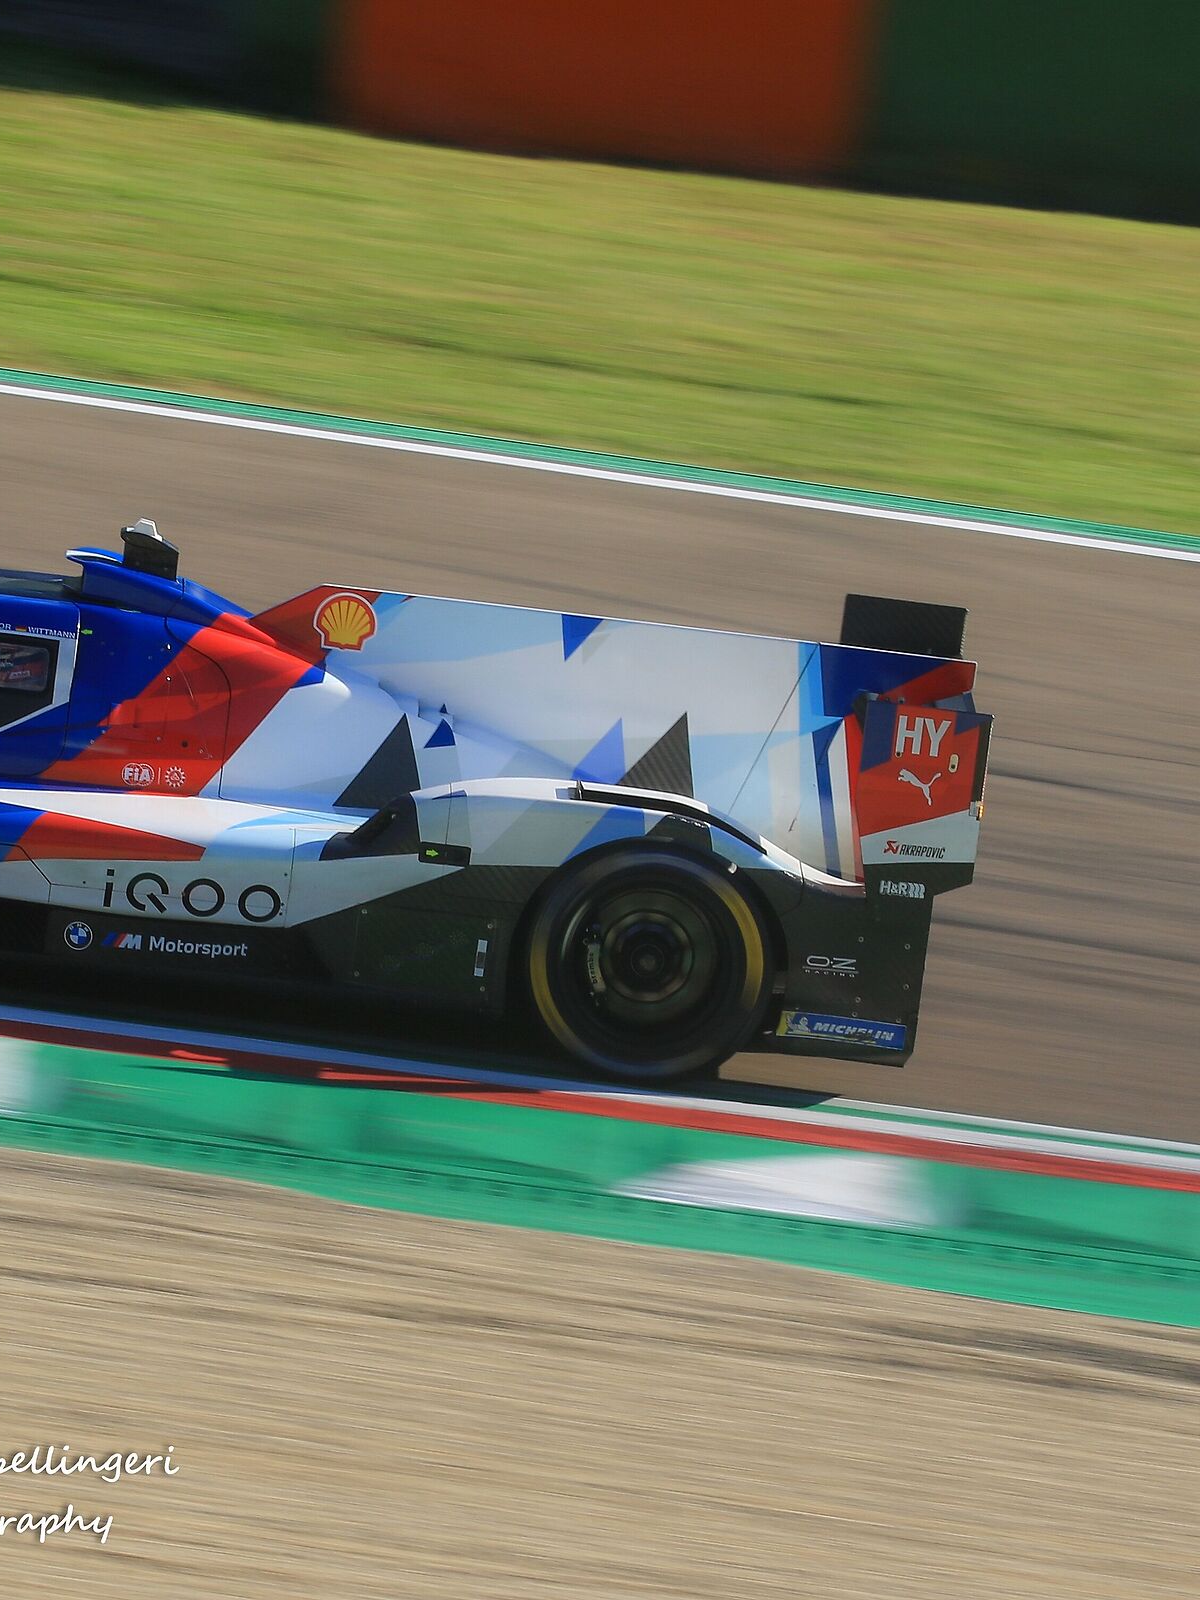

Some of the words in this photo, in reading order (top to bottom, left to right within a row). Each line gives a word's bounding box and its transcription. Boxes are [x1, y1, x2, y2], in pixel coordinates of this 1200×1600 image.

[27, 625, 76, 639] WITTMANN
[895, 715, 952, 758] HY
[102, 868, 283, 923] iQOO
[149, 936, 249, 958] Motorsport
